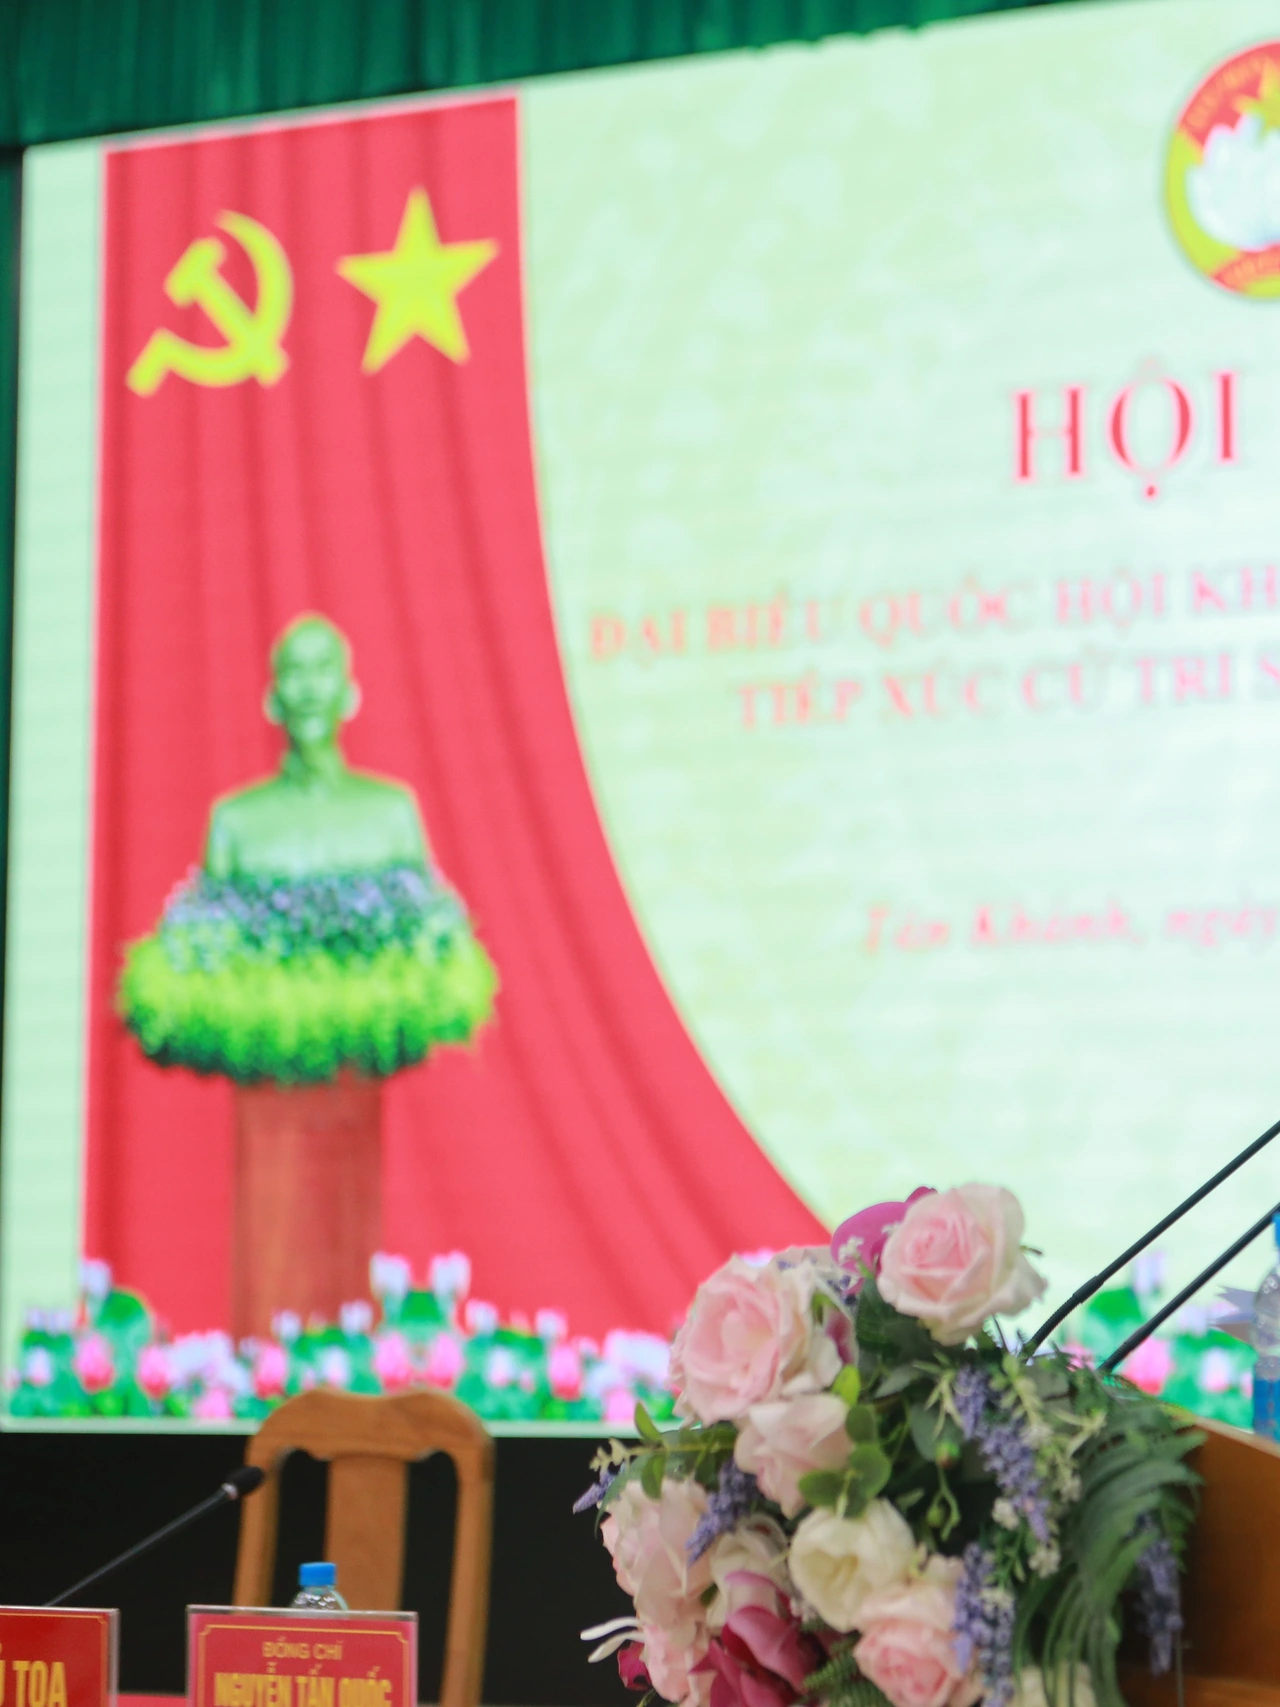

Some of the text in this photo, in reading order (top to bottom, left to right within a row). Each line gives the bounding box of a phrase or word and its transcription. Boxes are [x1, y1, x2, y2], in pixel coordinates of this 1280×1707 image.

[1010, 356, 1241, 500] HỘI
[588, 606, 689, 668] ĐẠI
[858, 572, 1034, 650] QUỐC
[1054, 566, 1167, 636] HỘI
[1133, 648, 1233, 706] TRI
